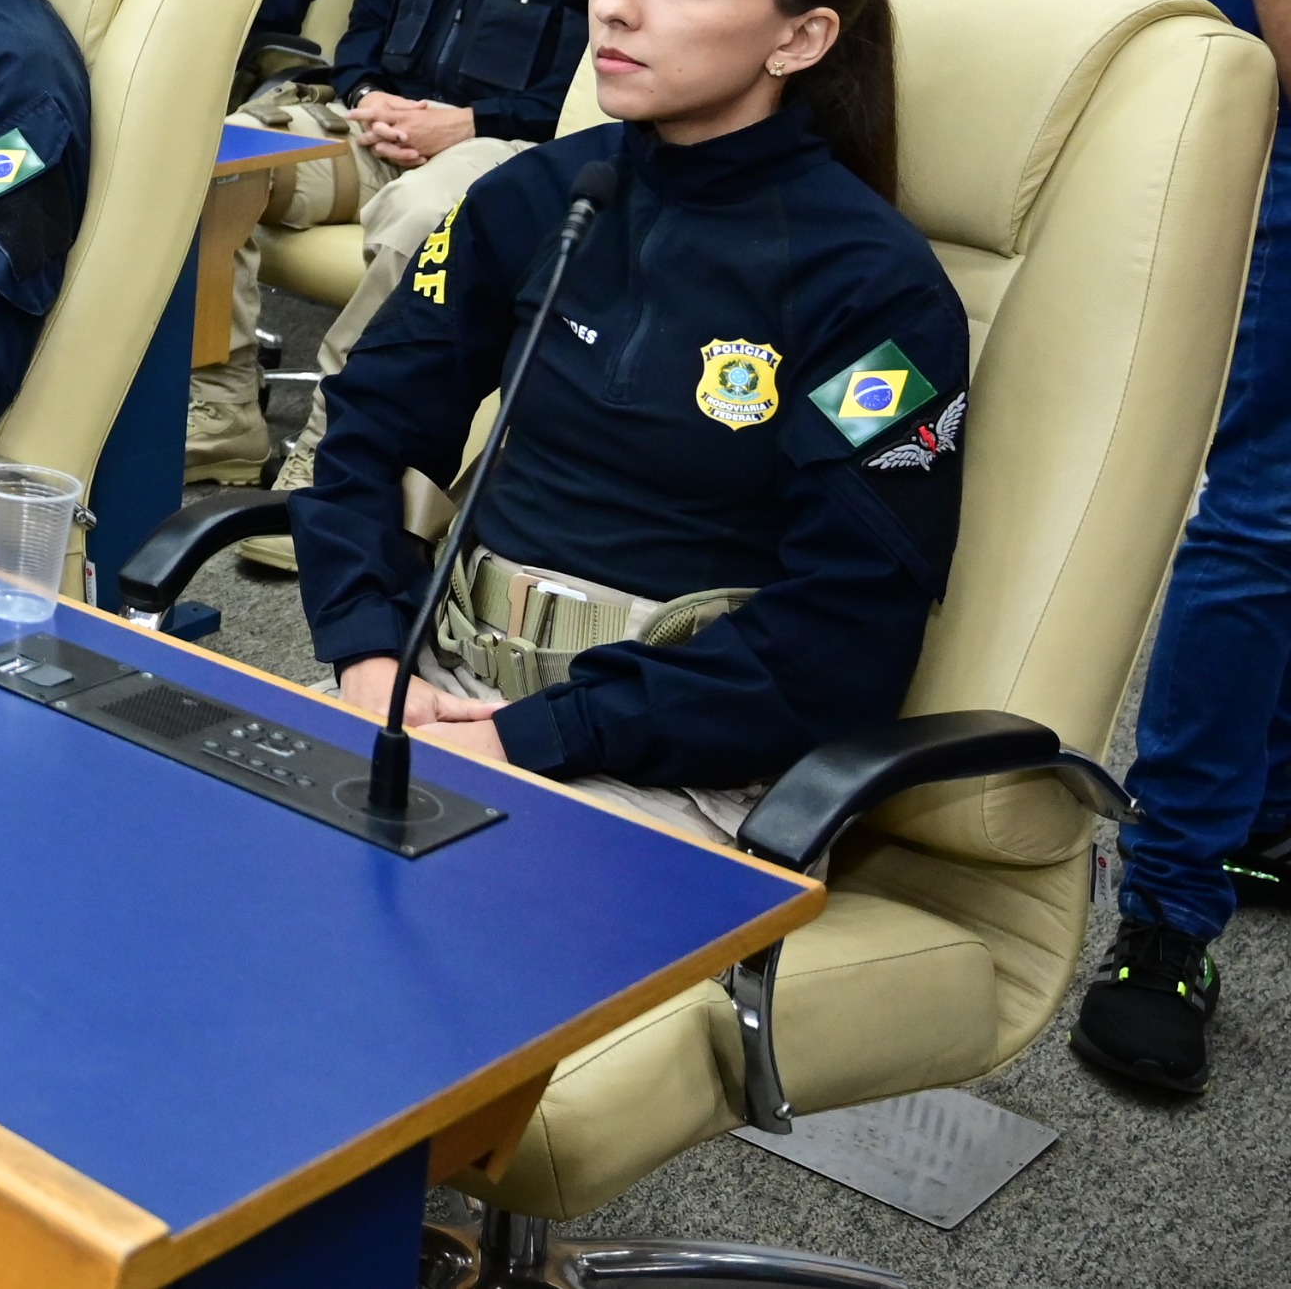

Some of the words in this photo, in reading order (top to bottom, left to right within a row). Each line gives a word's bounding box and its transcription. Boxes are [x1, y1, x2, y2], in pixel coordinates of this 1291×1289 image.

[562, 317, 598, 345] DES
[712, 344, 769, 361] POLICIA
[713, 410, 759, 422] FEDERAL
